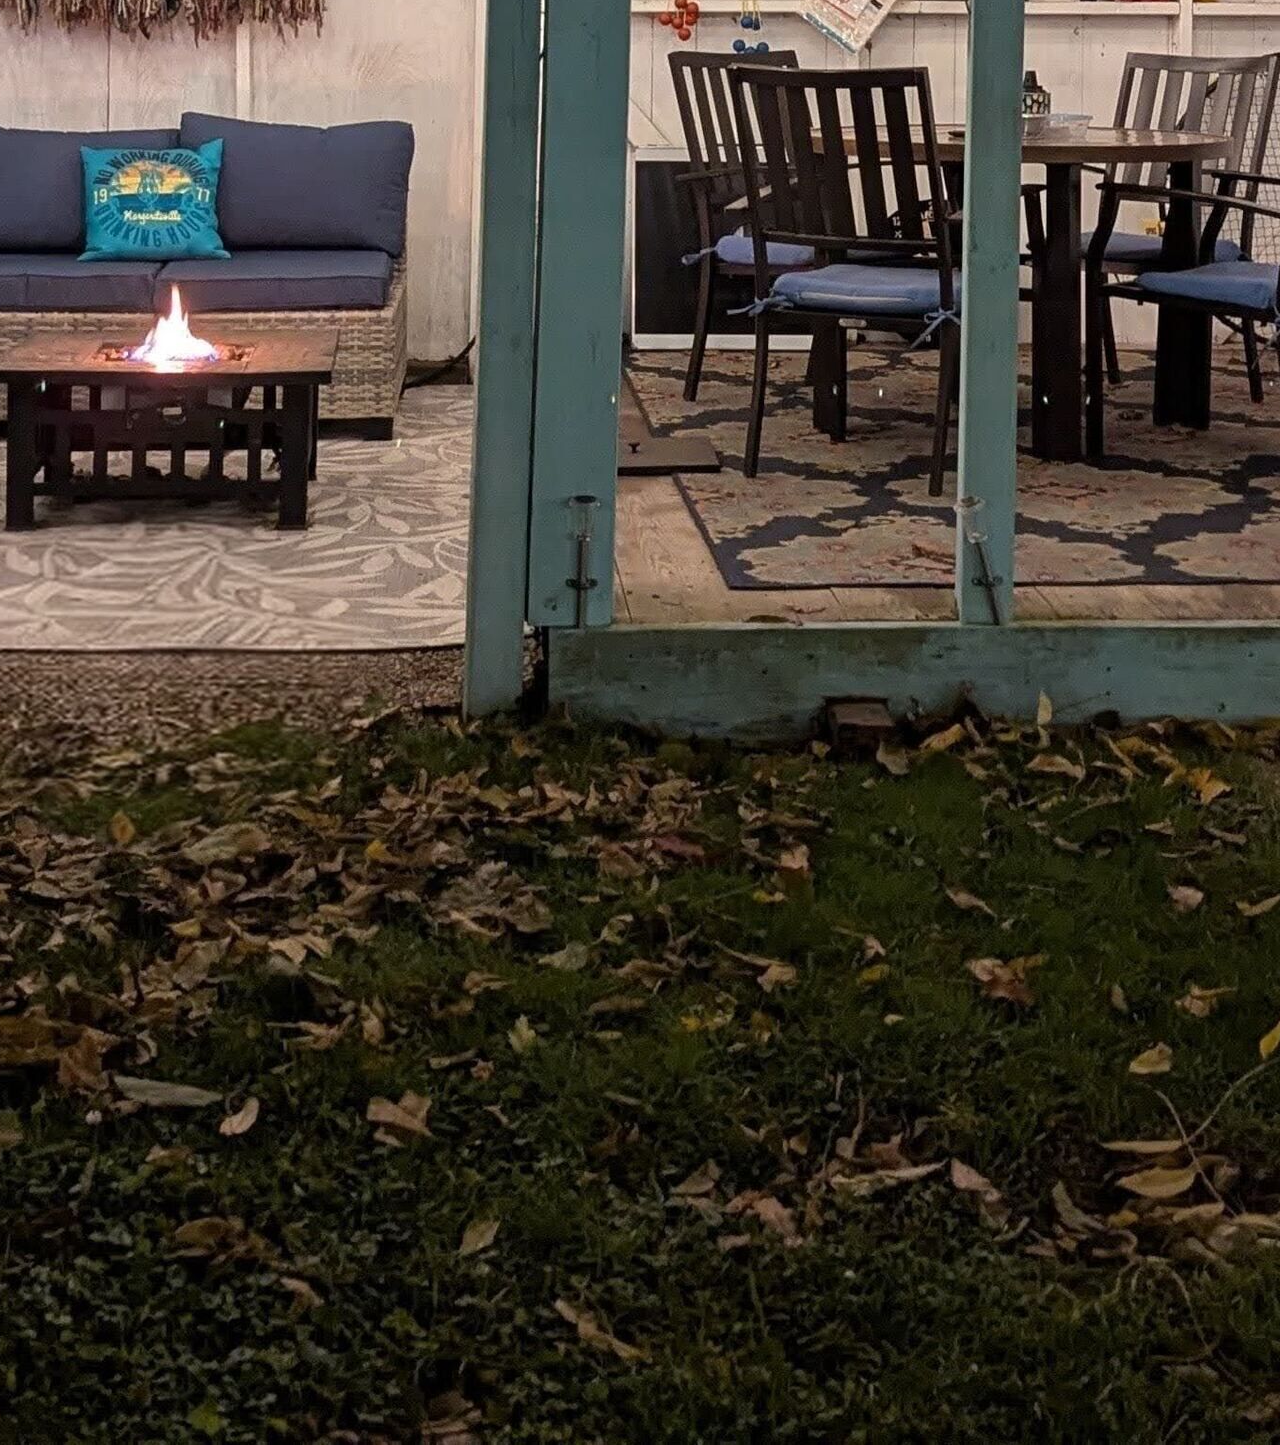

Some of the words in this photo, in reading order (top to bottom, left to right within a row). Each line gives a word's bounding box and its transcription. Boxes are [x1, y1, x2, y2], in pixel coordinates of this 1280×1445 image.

[92, 169, 115, 185] NO
[106, 151, 170, 170] WORKING
[169, 153, 210, 188] DURING
[93, 188, 108, 205] 19
[94, 204, 162, 248] DRINKING
[165, 203, 211, 245] HOURS
